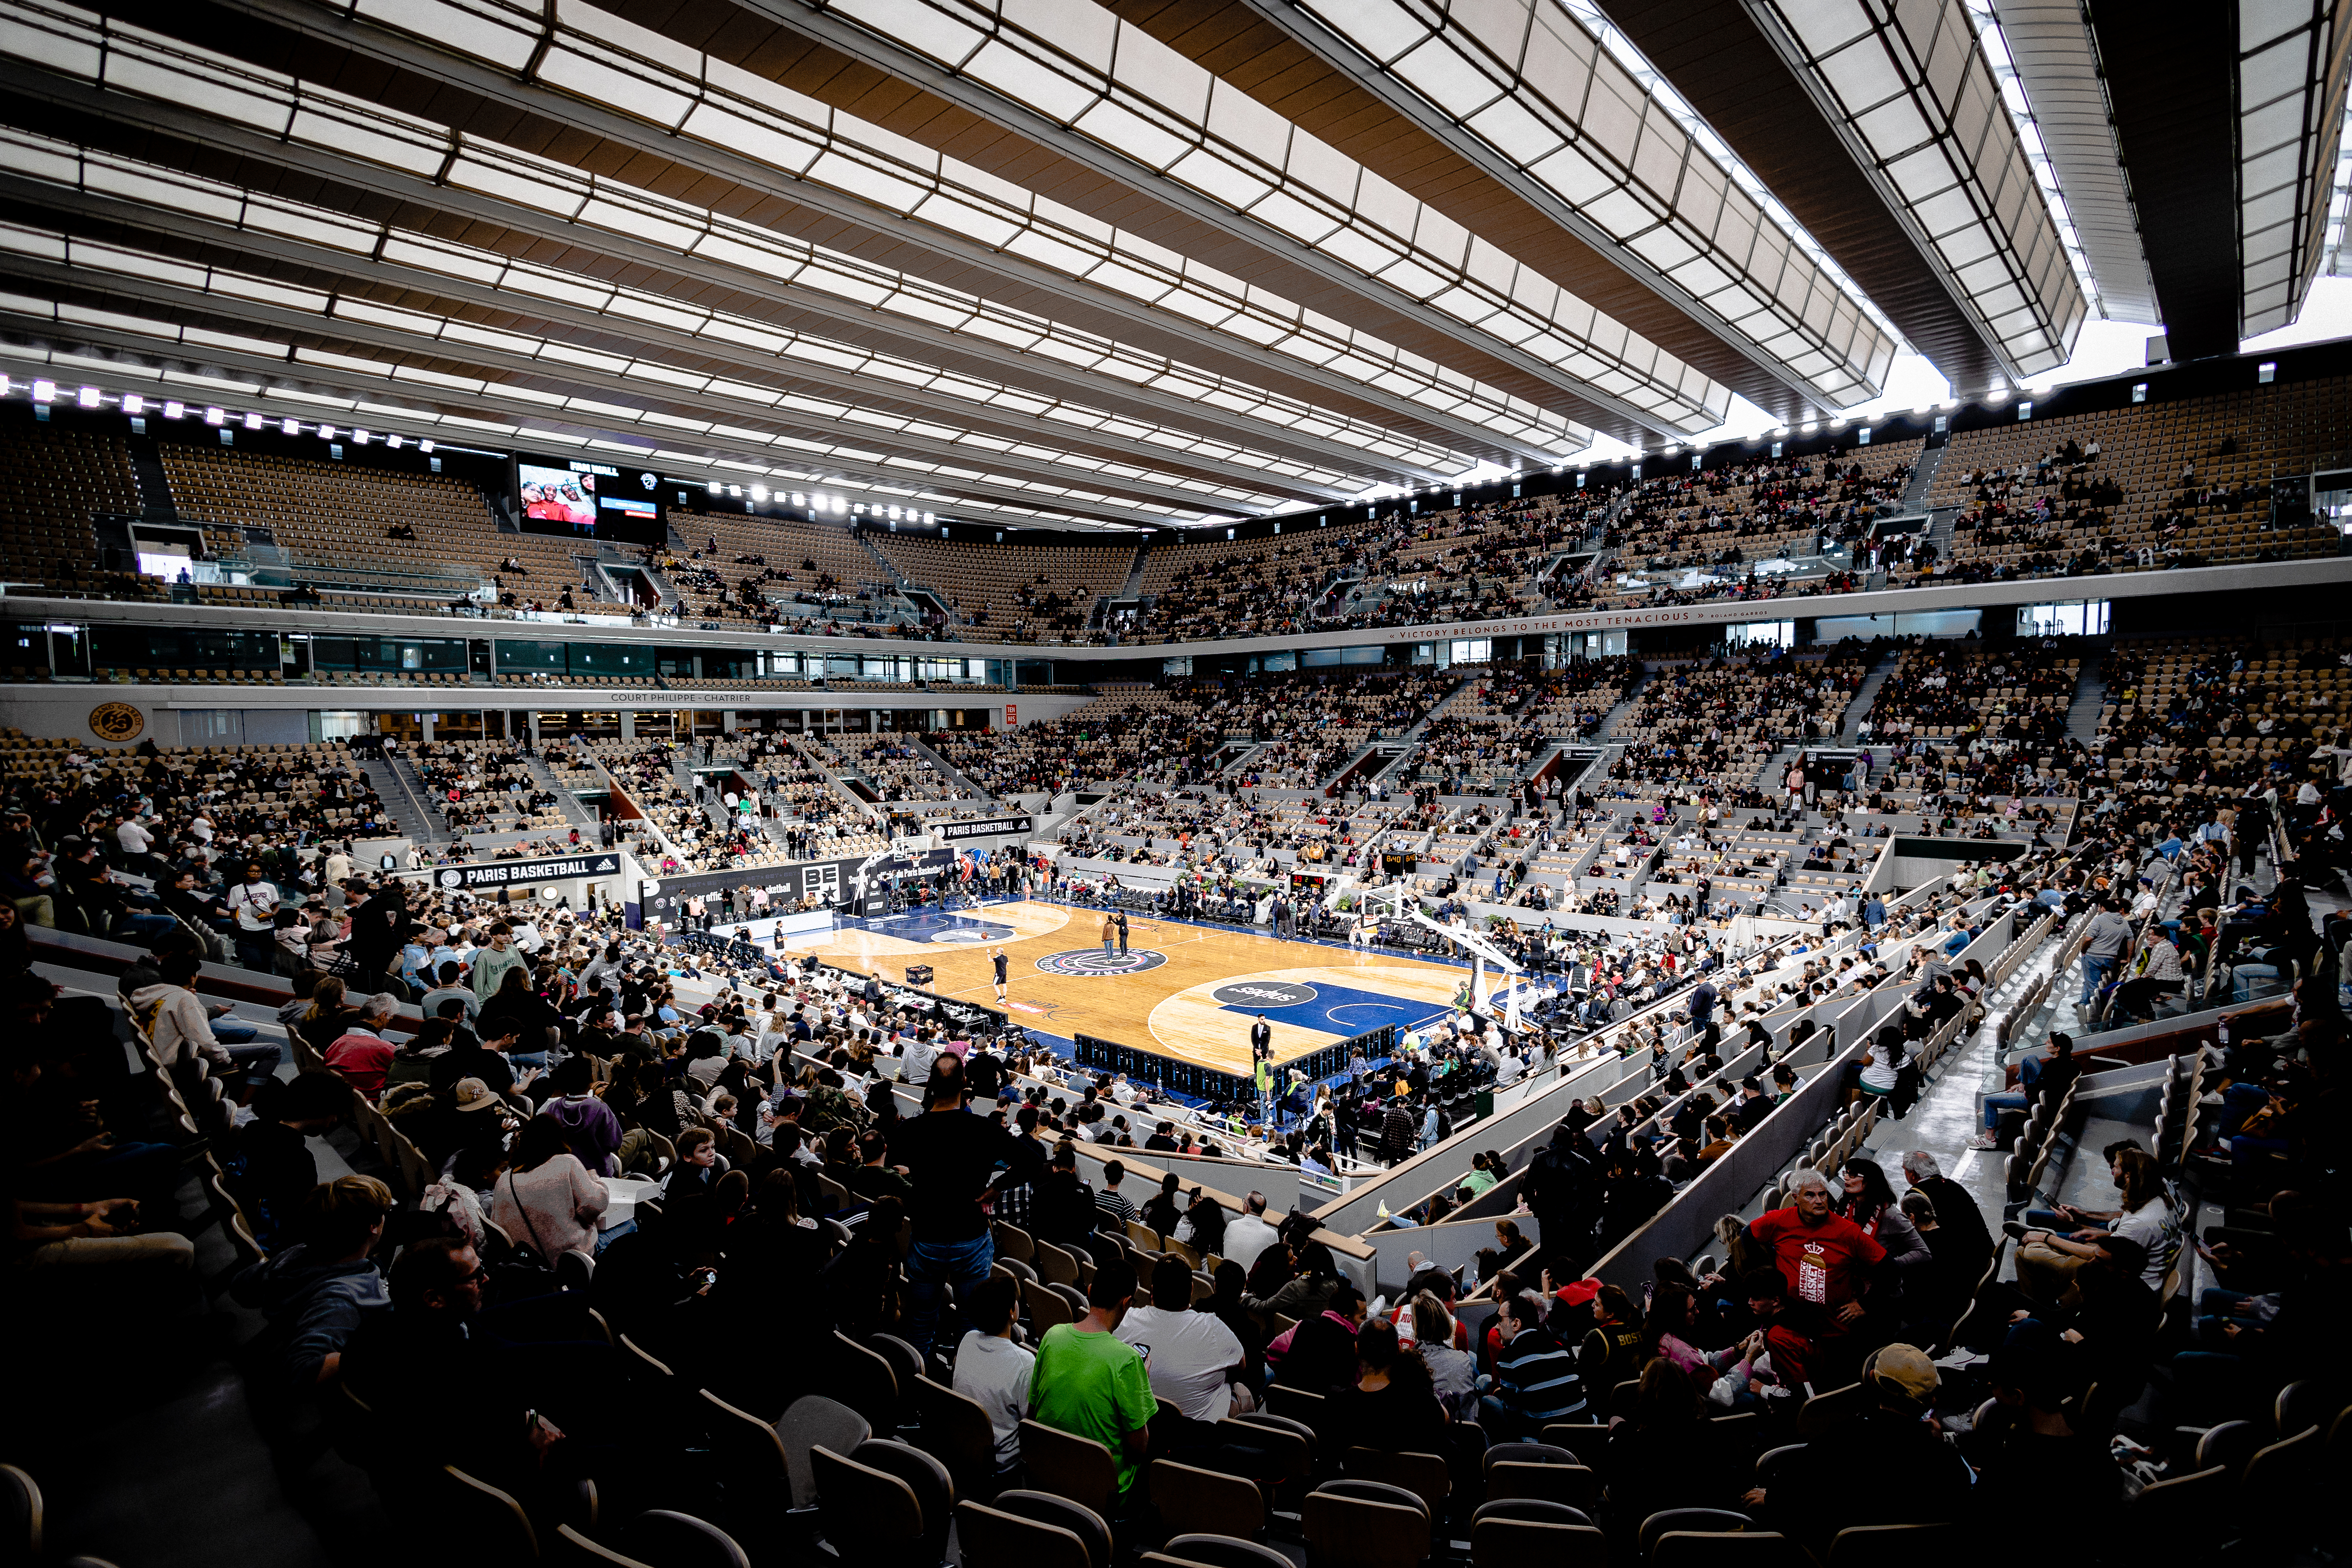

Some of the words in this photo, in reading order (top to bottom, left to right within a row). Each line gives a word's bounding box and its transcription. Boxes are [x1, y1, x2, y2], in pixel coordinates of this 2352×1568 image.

[570, 461, 591, 473] FAN
[591, 464, 619, 477] WALL
[1400, 629, 1447, 638] VICTORY
[1454, 625, 1506, 635] BELONGS
[1534, 621, 1557, 630] THE
[1565, 618, 1599, 628] MOST
[1607, 613, 1689, 625] TENACIOUS
[117, 705, 141, 726] GARROS
[948, 825, 970, 836] PARIS
[972, 821, 1014, 834] BASKETBALL
[467, 867, 508, 883] PARIS
[511, 861, 589, 879] BASKETBALL
[904, 868, 918, 878] Paris
[918, 864, 945, 877] Basketball
[1025, 999, 1060, 1009] ELITE
[1807, 1263, 1818, 1302] BASKET
